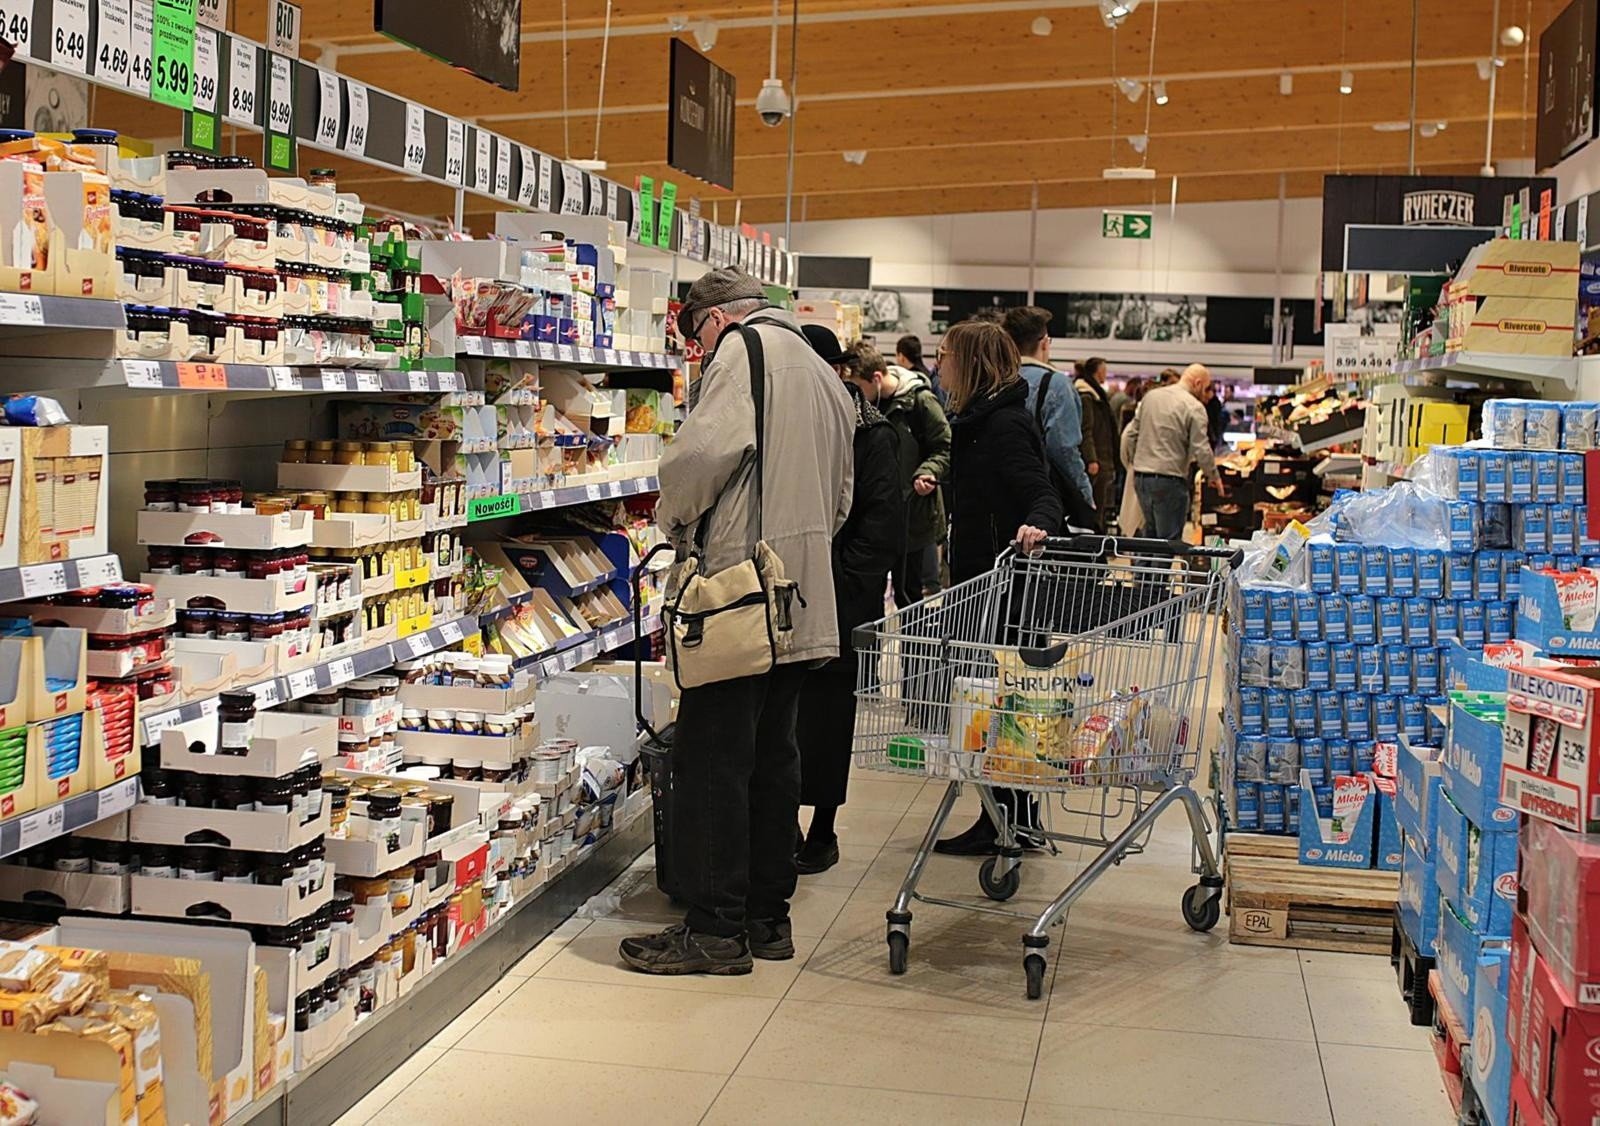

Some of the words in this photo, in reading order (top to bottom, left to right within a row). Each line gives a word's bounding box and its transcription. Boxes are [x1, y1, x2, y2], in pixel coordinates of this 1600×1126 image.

[56, 27, 85, 60] 6.49
[100, 43, 128, 75] 4.69
[133, 54, 152, 83] 4.6
[156, 55, 189, 96] 5.99
[232, 86, 254, 114] 8.99
[271, 99, 290, 124] 9.99
[321, 115, 337, 139] 1.99
[350, 124, 365, 147] 1.99
[1403, 194, 1475, 224] RYNECZEK
[475, 499, 514, 516] Nowość!
[1565, 591, 1594, 602] Mleko
[1510, 672, 1584, 708] MLEKOVITA
[1336, 793, 1365, 804] Mleko
[1324, 850, 1364, 863] Mleko
[1246, 914, 1272, 928] EPAL
